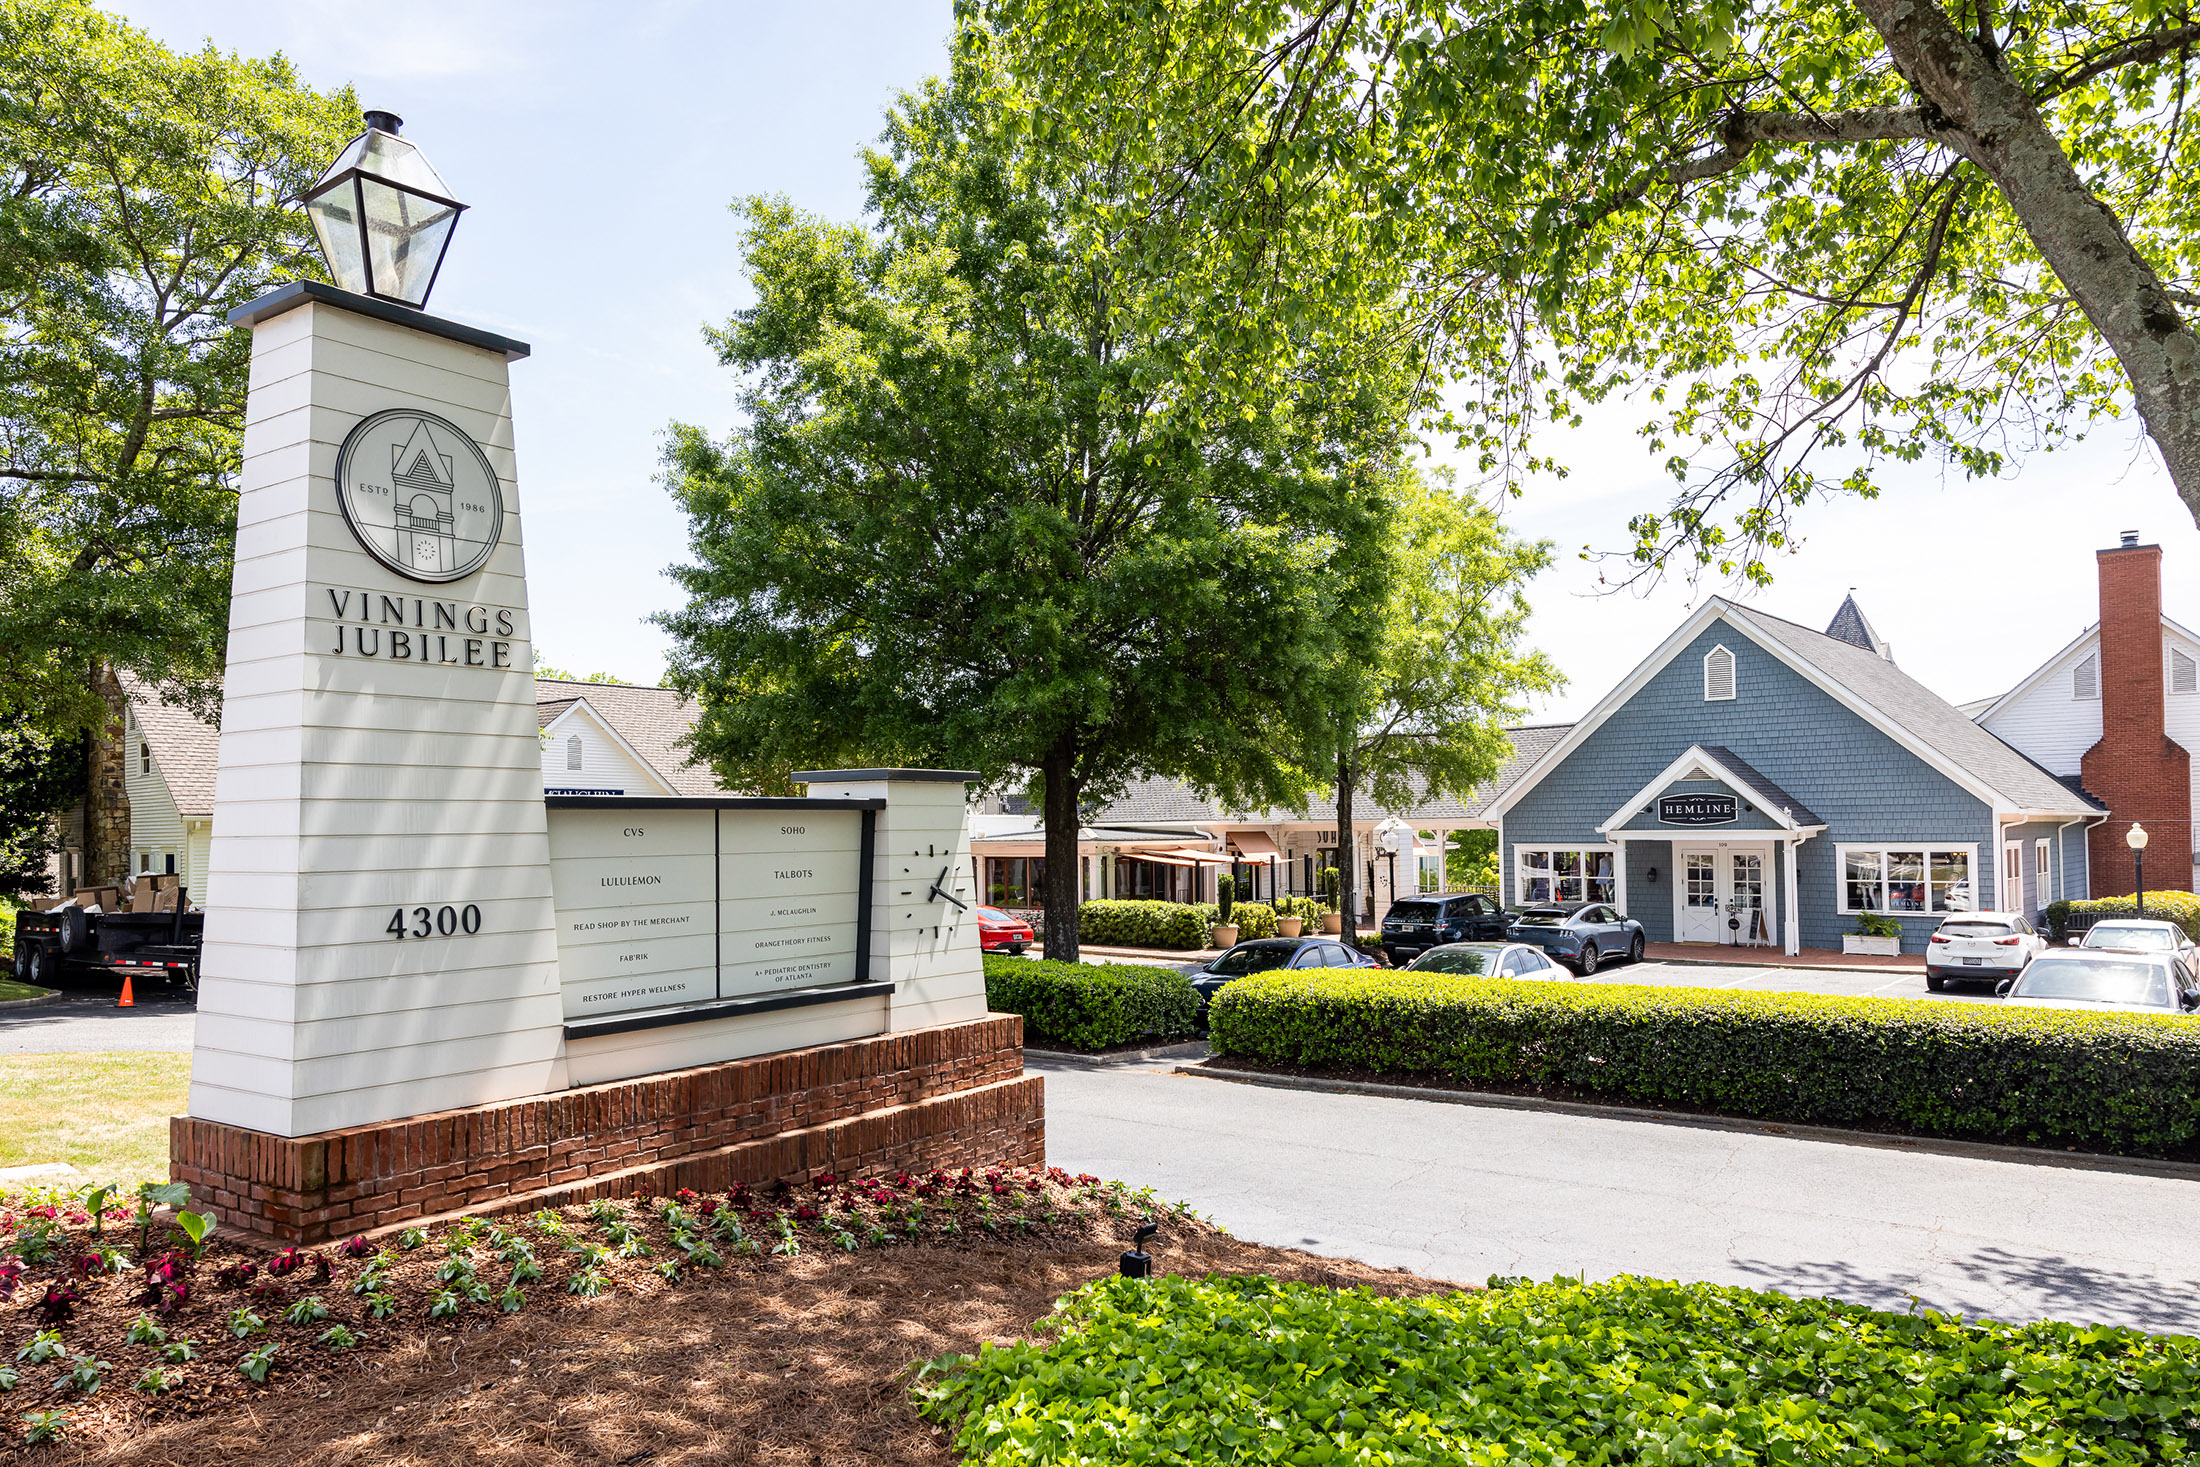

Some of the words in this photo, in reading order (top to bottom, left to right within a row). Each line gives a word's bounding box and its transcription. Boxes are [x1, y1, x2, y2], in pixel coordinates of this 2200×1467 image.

[460, 502, 485, 513] 1986
[326, 588, 514, 637] VININGS
[331, 624, 512, 668] JUBILEE
[1665, 804, 1731, 814] HEMLINE
[623, 827, 645, 838] CVS
[780, 826, 806, 835] SOHO
[774, 869, 813, 879] TALBOTS
[601, 875, 661, 887] LULULEMON
[777, 907, 817, 916] MCLAUGHLIN
[385, 904, 482, 939] 4300
[573, 922, 596, 931] READ
[597, 920, 619, 930] SHOP
[620, 919, 631, 928] BY
[633, 918, 648, 927] THE
[650, 916, 690, 926] MERCHANT
[754, 938, 806, 949] ORANGETHEORY
[806, 935, 831, 944] FITNESS
[619, 953, 649, 962] FAB'RIK
[764, 966, 797, 976] PEDIATRIC
[798, 962, 832, 972] DENTISTRY
[775, 975, 784, 983] OF
[784, 972, 813, 982] ATLANTA
[582, 991, 618, 1003] RESTORE
[620, 988, 647, 998] HYPER
[648, 983, 686, 994] WELLNESS
